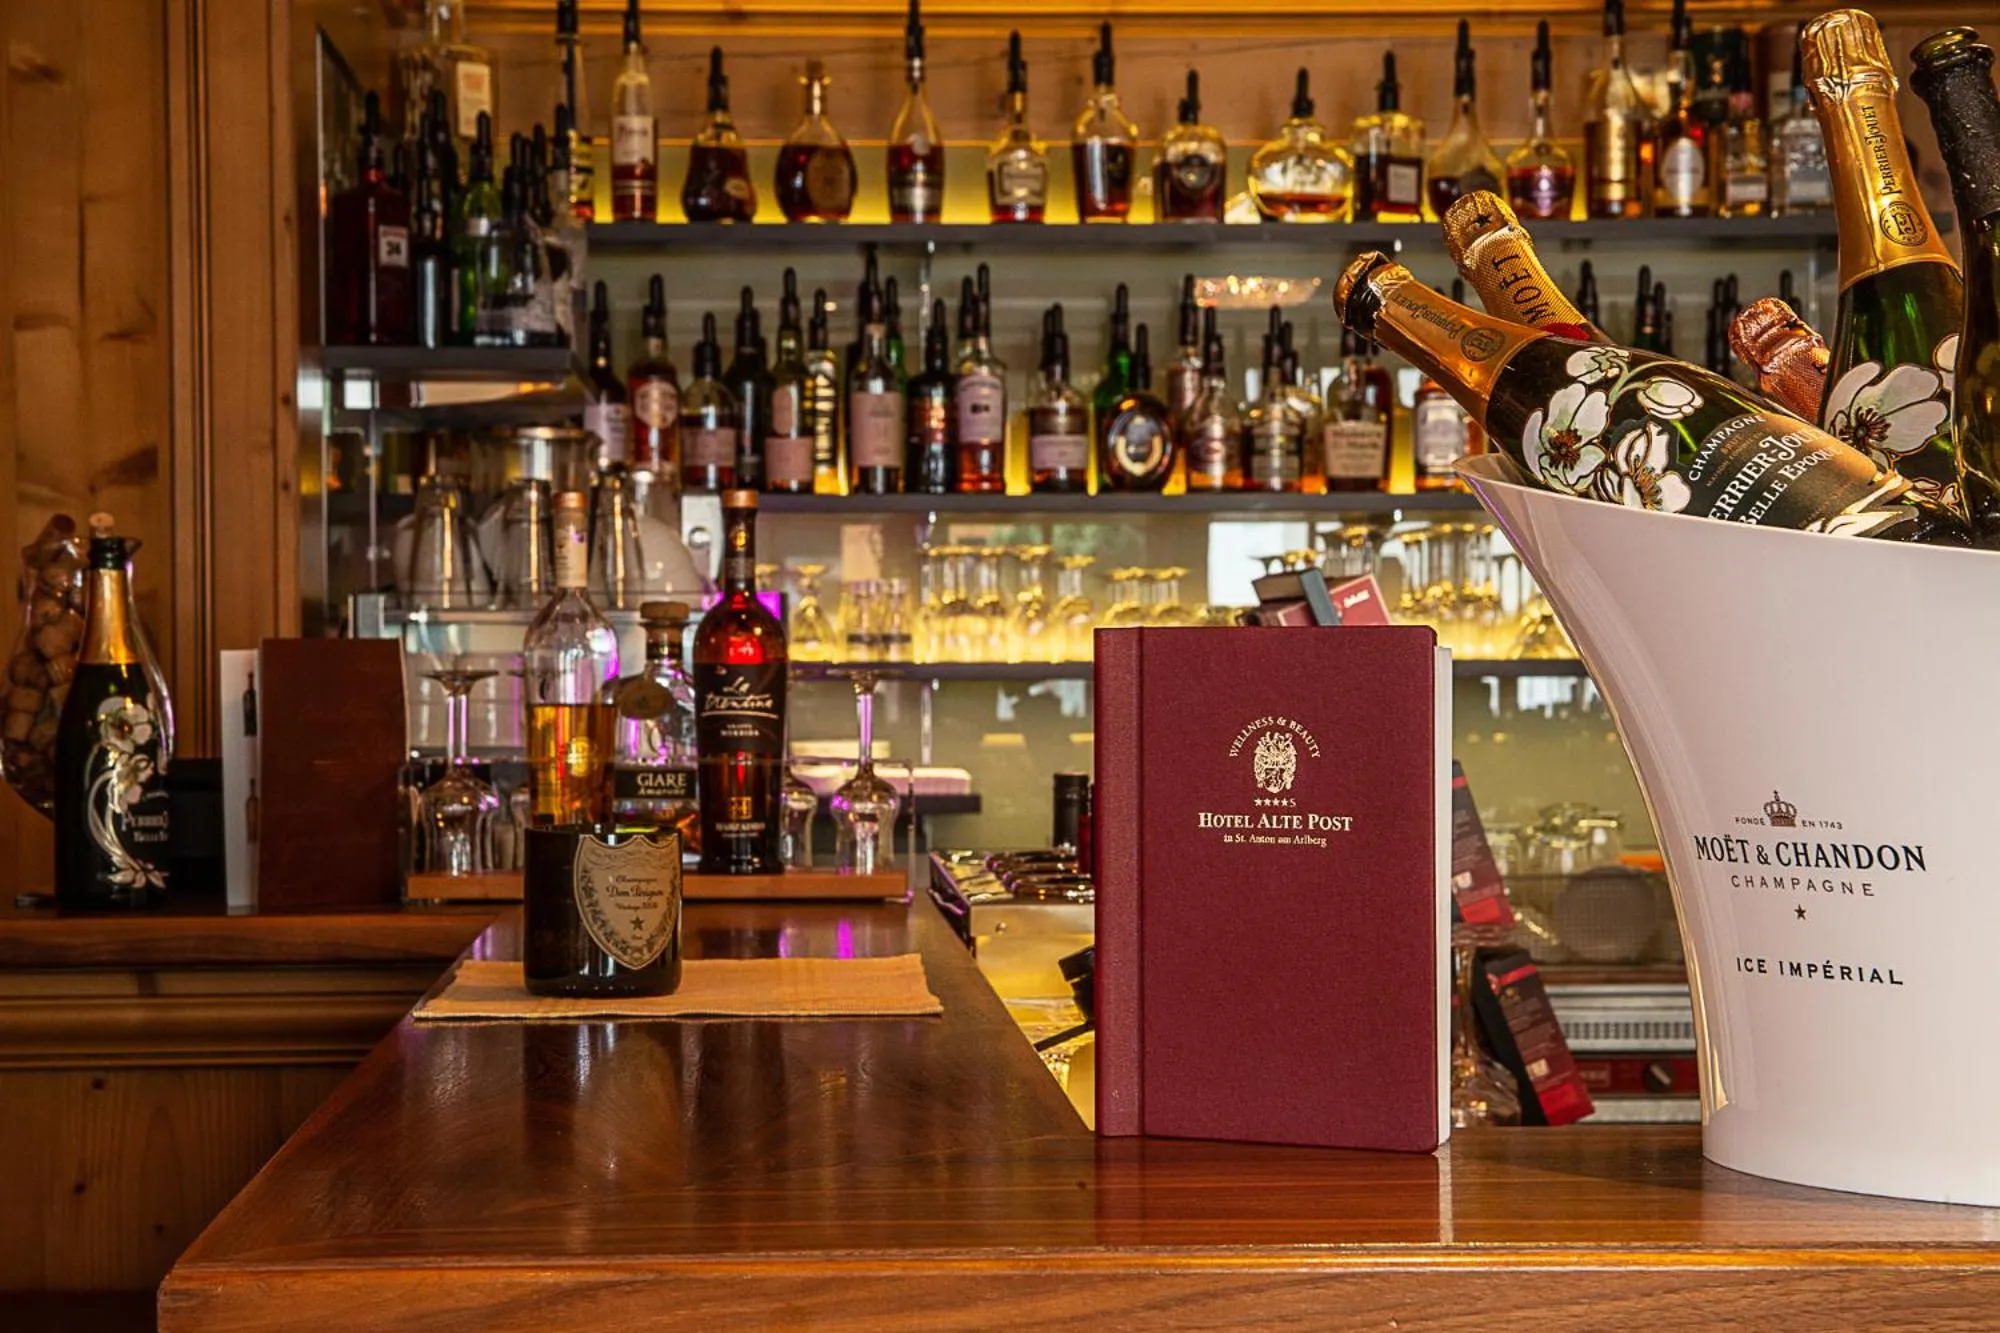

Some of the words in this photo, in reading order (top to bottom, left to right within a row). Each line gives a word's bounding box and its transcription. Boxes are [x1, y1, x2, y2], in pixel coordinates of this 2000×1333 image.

[1688, 415, 1766, 482] CHAMPAGNE
[1229, 716, 1274, 757] WELLNESS
[1276, 716, 1288, 726] &
[1289, 720, 1321, 758] BEAUTY
[636, 772, 687, 788] GIARE
[1198, 812, 1254, 828] HOTEL
[1257, 813, 1303, 829] ALTE
[1308, 813, 1353, 832] POST
[1801, 819, 1816, 828] EN
[1819, 820, 1843, 830] 1743
[1235, 833, 1246, 843] St.
[1249, 834, 1276, 844] Anton
[1278, 836, 1291, 844] am
[1293, 834, 1327, 848] Arlberg
[1694, 834, 1750, 864] MOËT
[1756, 844, 1772, 866] &
[1775, 841, 1927, 872] CHANDON
[1731, 875, 1875, 897] CHAMPAGNE
[1736, 957, 1768, 974] ICE
[1779, 960, 1904, 985] IMPÉRIAL
